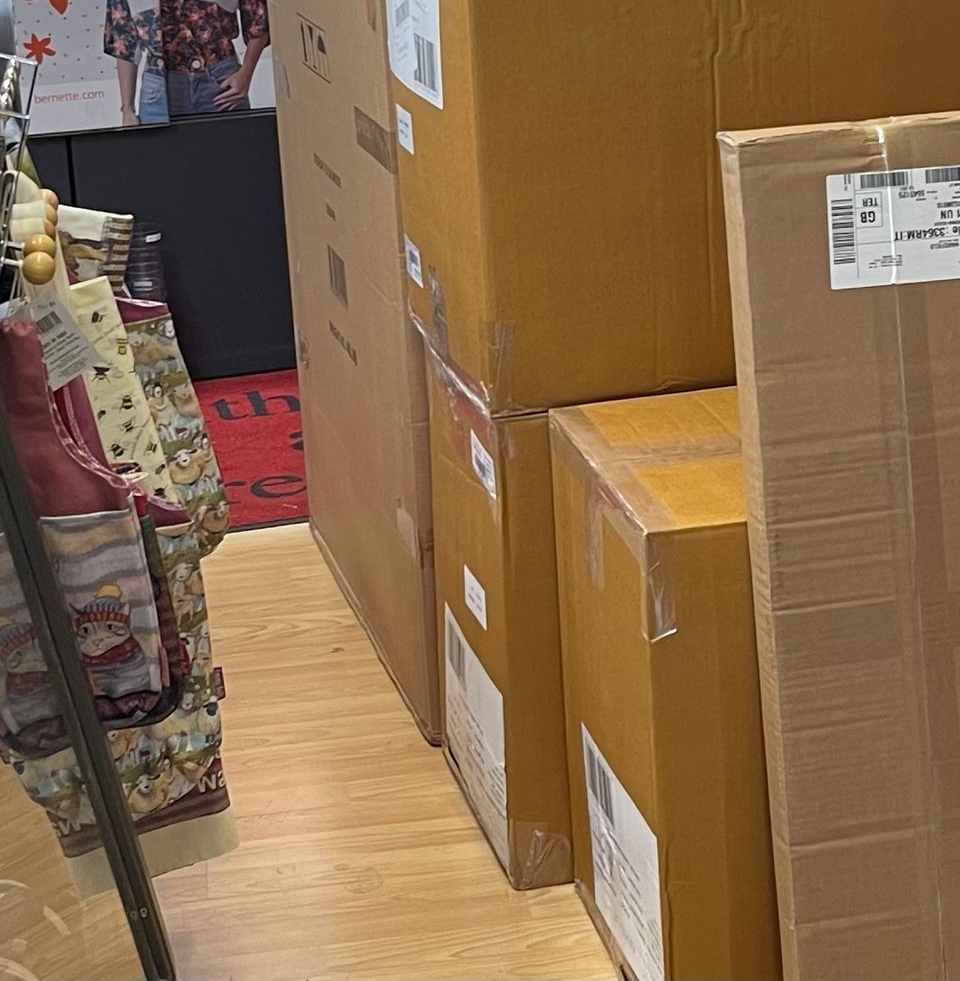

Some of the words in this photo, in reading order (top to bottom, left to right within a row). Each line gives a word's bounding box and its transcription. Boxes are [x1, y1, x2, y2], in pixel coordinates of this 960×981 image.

[34, 89, 105, 104] bernette.com
[862, 197, 878, 207] TER
[860, 211, 876, 223] GB
[940, 209, 954, 219] UN
